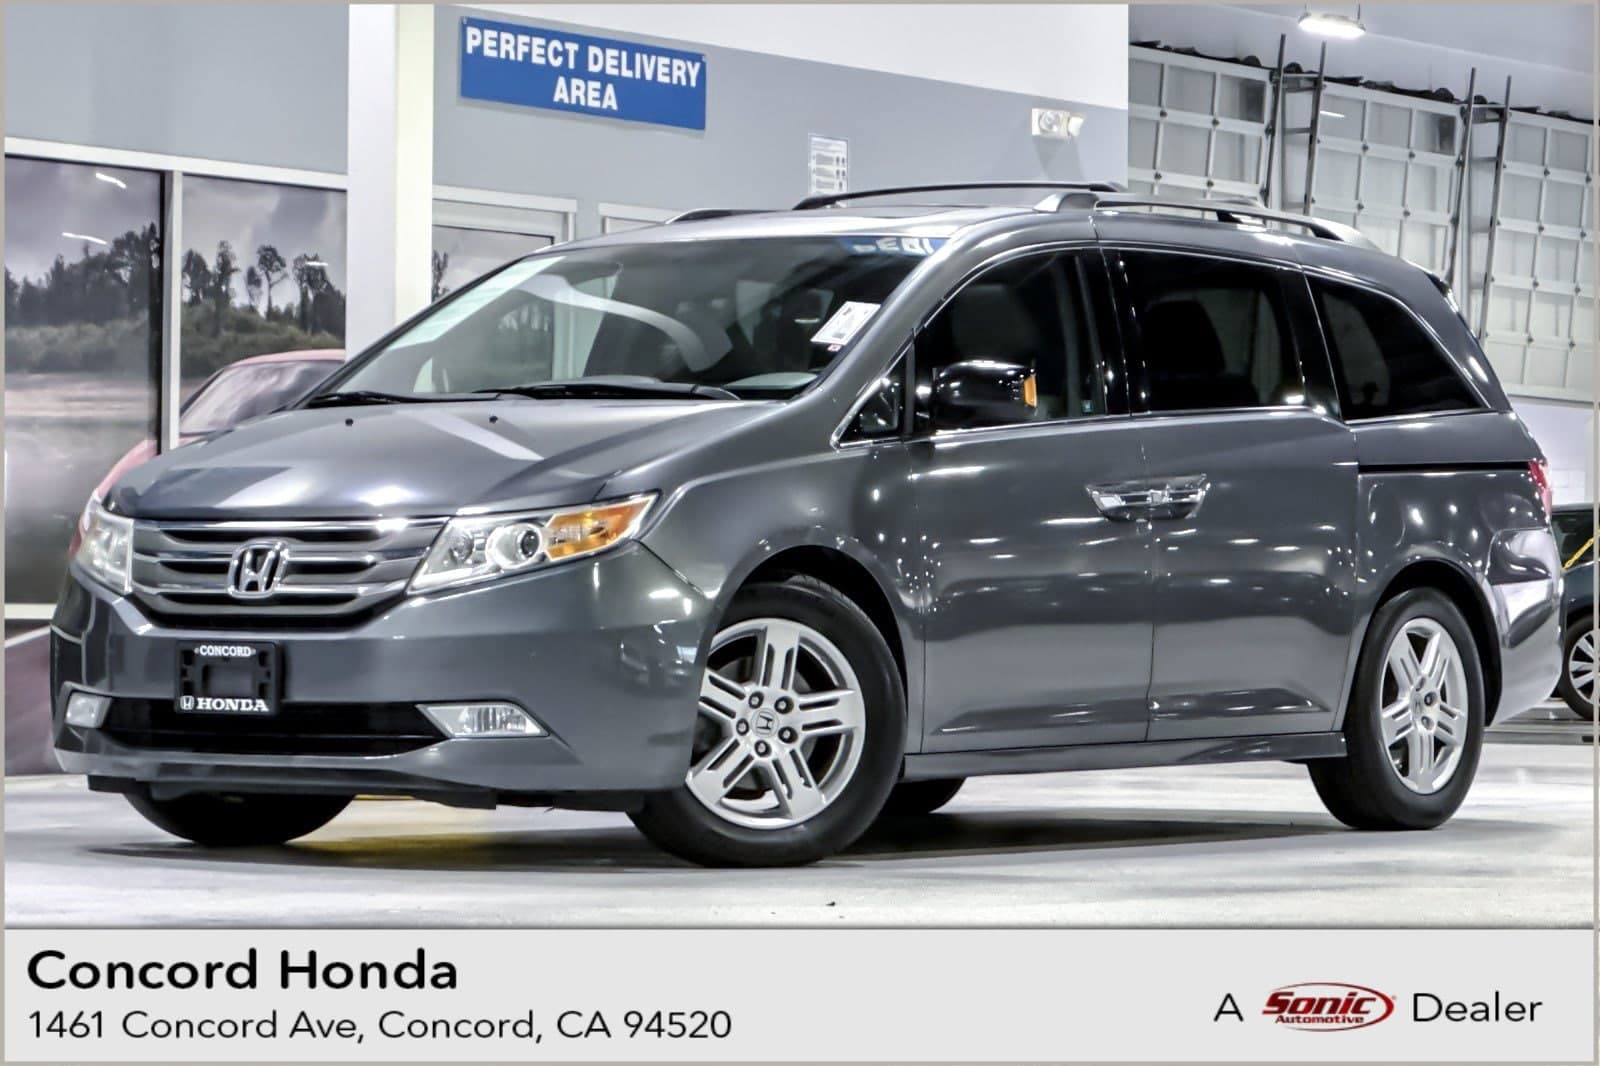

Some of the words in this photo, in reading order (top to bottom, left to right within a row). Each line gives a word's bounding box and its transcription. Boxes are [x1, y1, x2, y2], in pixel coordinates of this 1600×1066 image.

[466, 26, 579, 69] PERFECT
[588, 45, 700, 88] DELIVERY
[553, 76, 618, 111] AREA
[200, 645, 251, 657] CONCORD
[197, 698, 269, 712] HONDA
